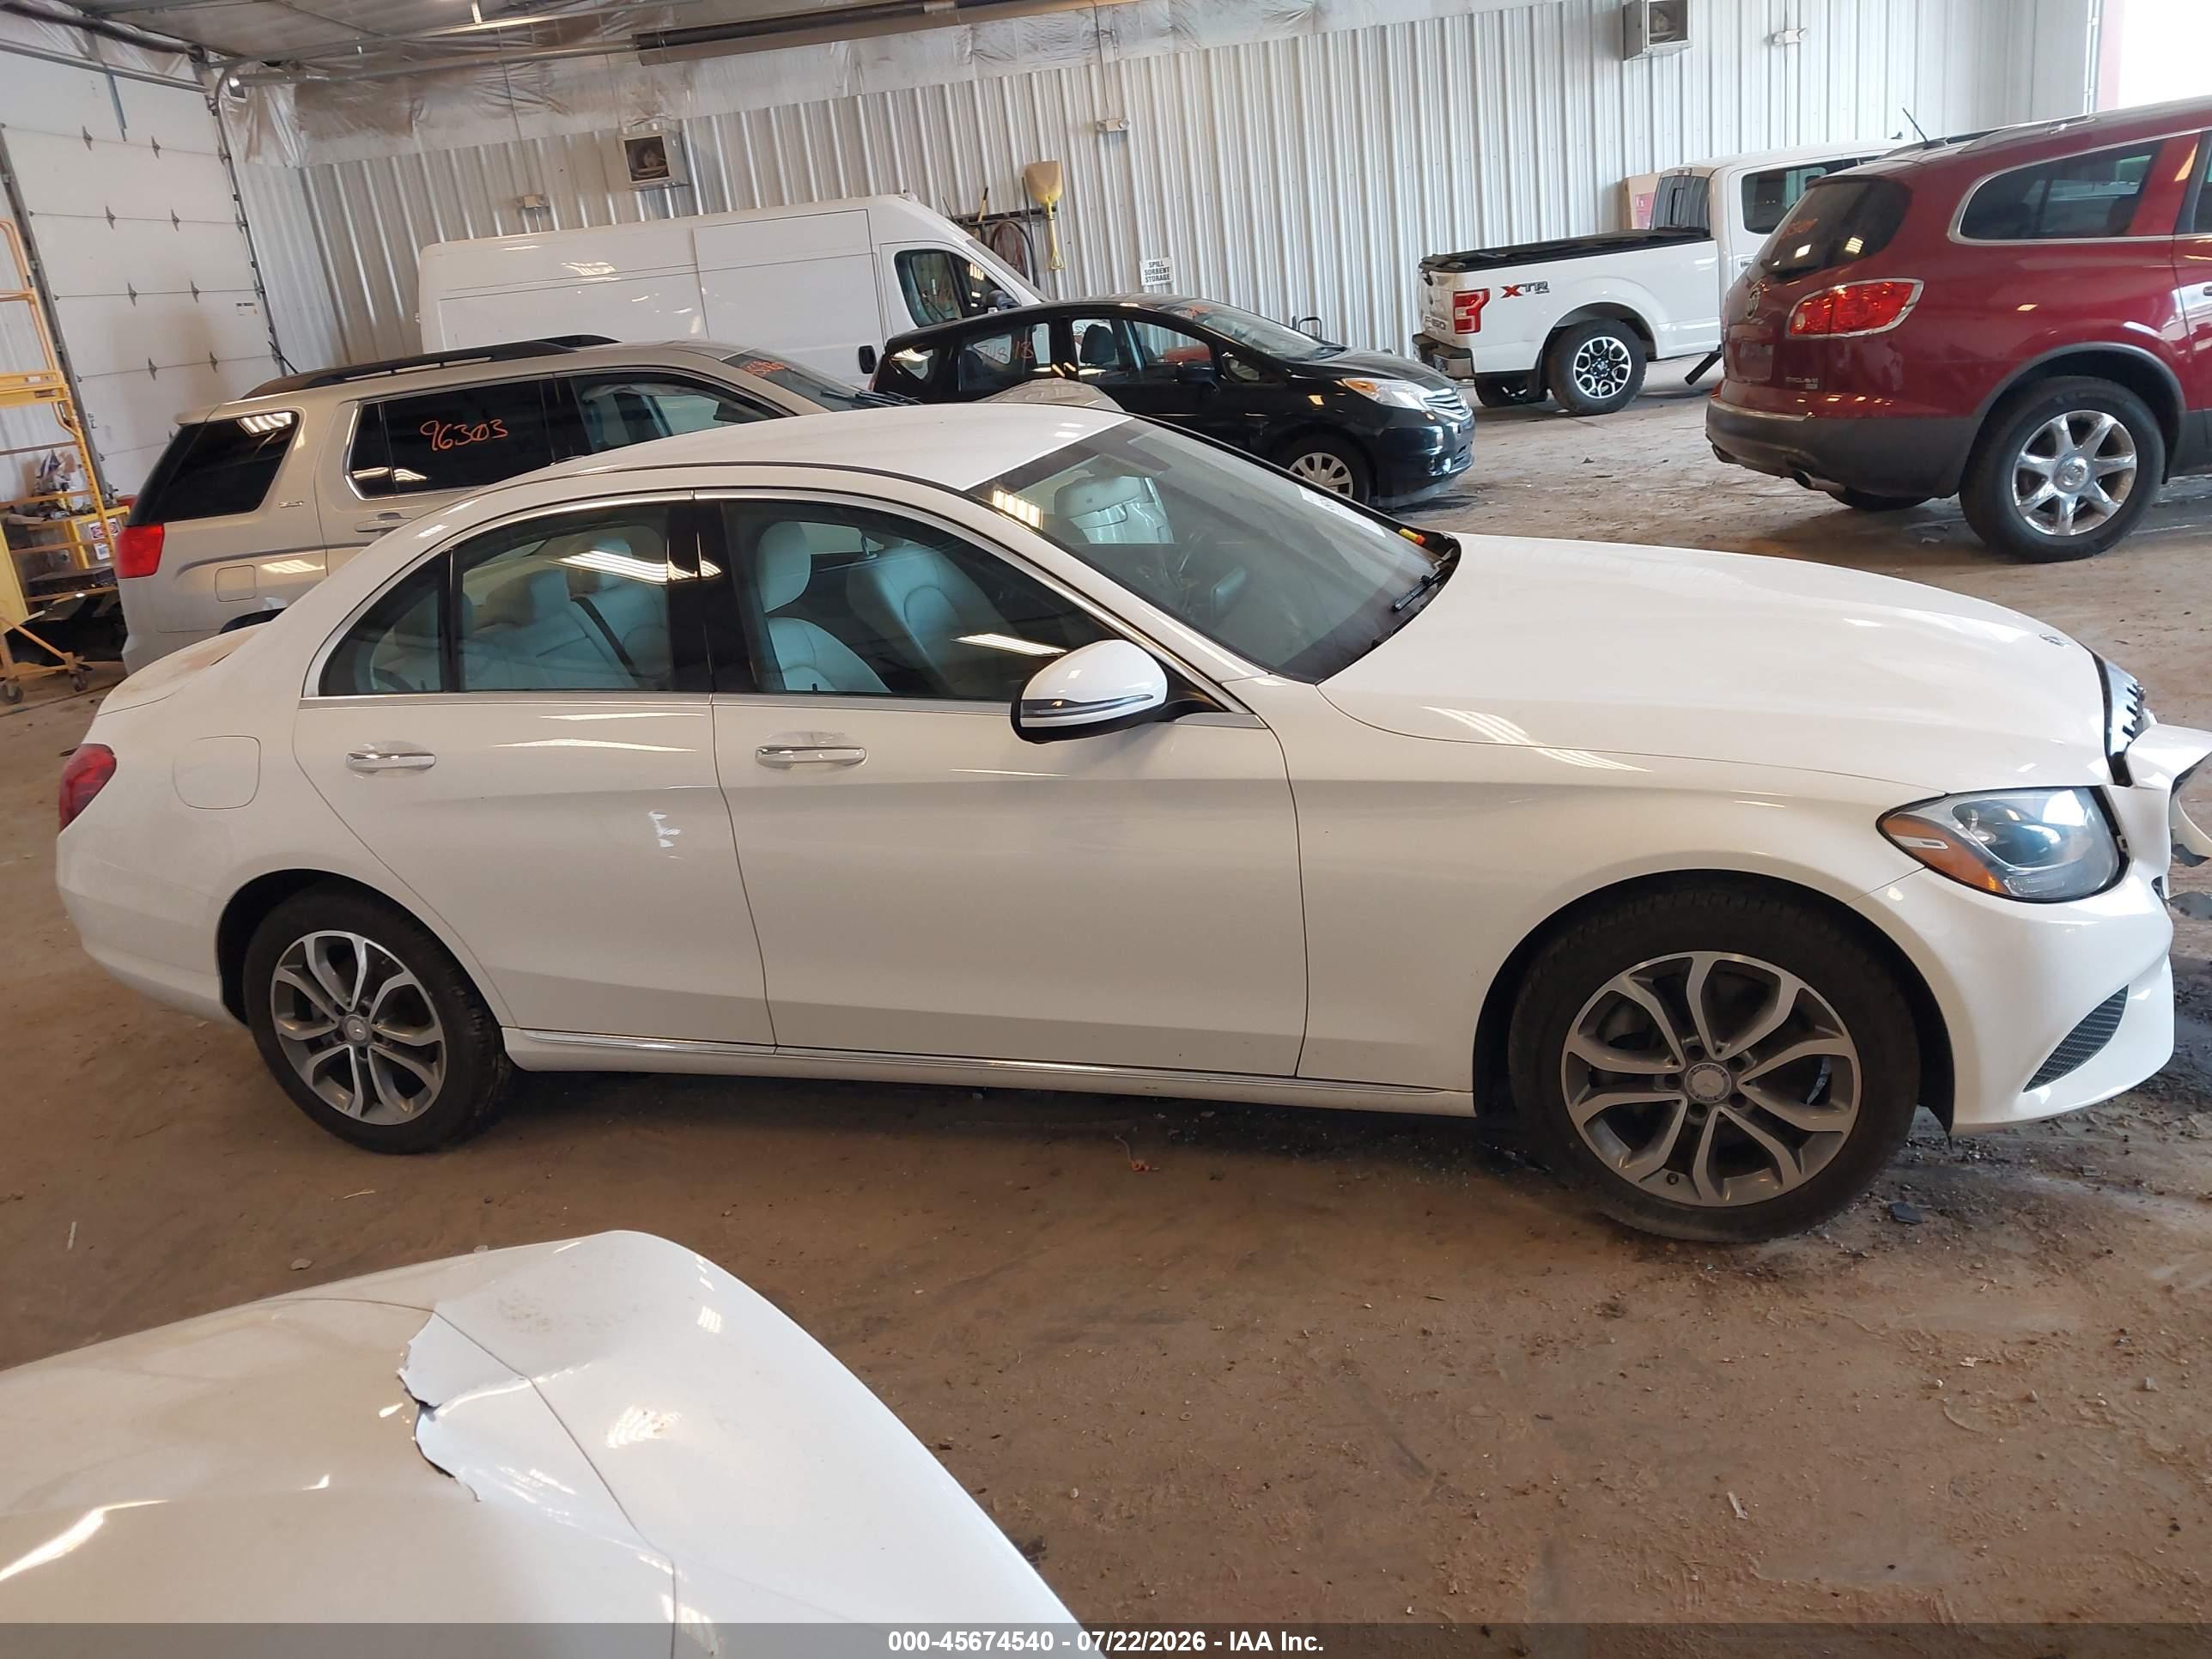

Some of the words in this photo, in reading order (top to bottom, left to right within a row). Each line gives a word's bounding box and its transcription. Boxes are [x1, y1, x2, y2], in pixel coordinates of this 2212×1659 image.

[1145, 274, 1170, 283] STORAGE
[1499, 282, 1549, 299] XTR
[420, 419, 508, 451] 96303
